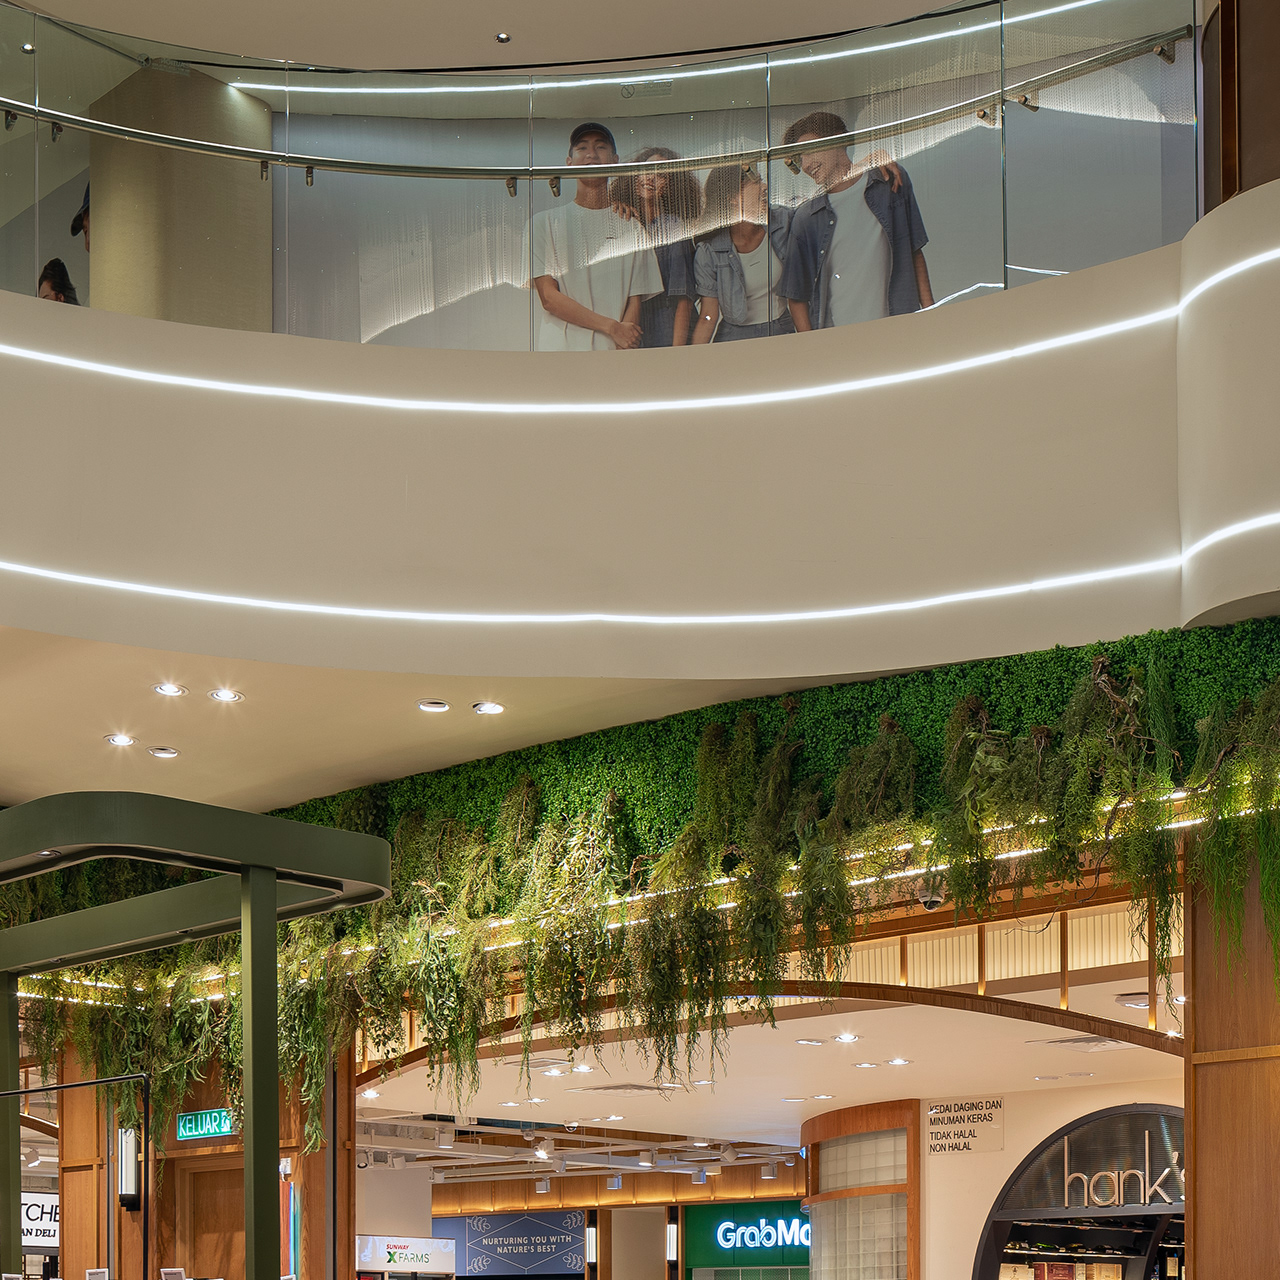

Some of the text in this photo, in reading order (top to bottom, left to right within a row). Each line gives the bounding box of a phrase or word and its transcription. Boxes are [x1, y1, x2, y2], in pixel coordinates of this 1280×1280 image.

[954, 1101, 984, 1113] DAGING
[985, 1100, 1002, 1110] DAN
[179, 1111, 220, 1136] KELUAR
[929, 1112, 993, 1126] MINUMAN KERAS
[929, 1129, 977, 1141] TIDAK HALAL
[929, 1141, 972, 1153] NON HALAL
[717, 1218, 811, 1248] GrabMa
[482, 1235, 572, 1245] NURTURING YOU WITH
